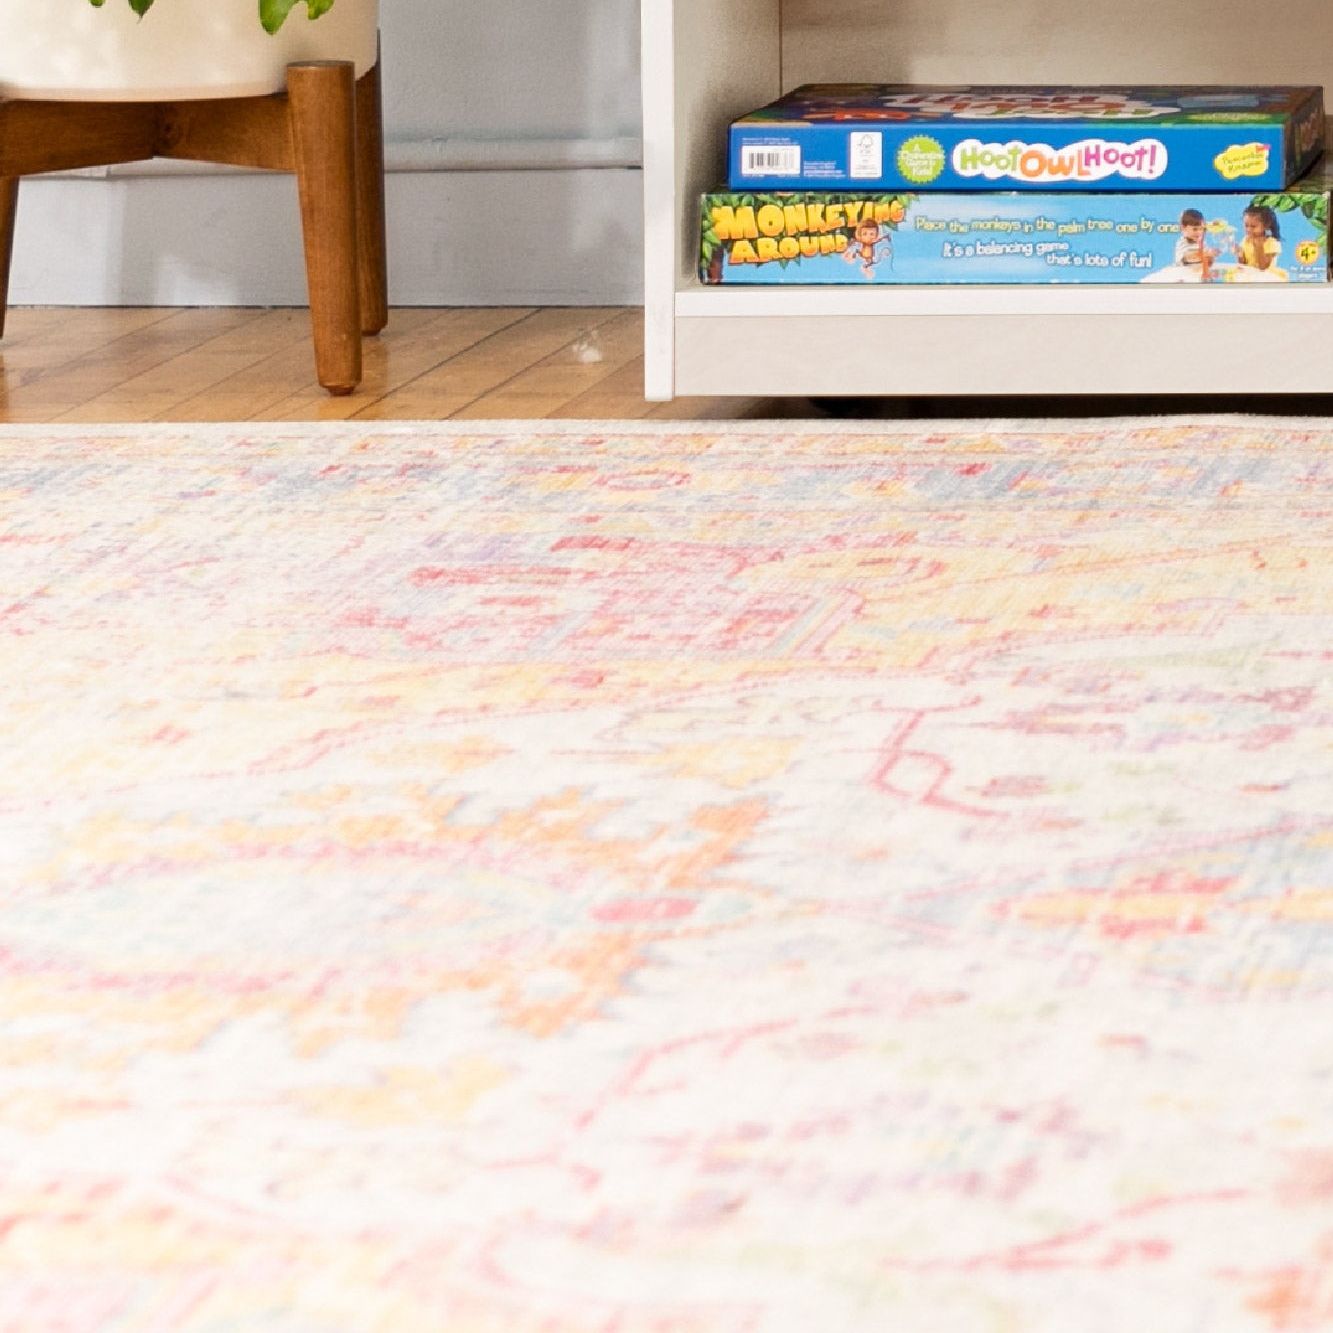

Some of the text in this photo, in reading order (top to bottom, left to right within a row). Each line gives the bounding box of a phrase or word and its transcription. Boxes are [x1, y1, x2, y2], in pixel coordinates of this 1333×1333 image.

[960, 145, 1022, 171] Hoot
[1084, 145, 1157, 174] Hoot!
[711, 201, 904, 240] MONKEYING
[949, 219, 969, 233] the
[971, 216, 1021, 232] monkeys
[1036, 216, 1055, 231] the
[1058, 220, 1085, 237] palm
[1087, 219, 1113, 231] tree
[1116, 223, 1137, 233] one
[1141, 217, 1154, 232] by
[728, 235, 848, 264] AROUND
[976, 239, 1033, 257] balancing
[1036, 242, 1069, 256] game
[1046, 252, 1082, 265] that's
[1085, 253, 1108, 267] lots
[1111, 252, 1126, 266] of
